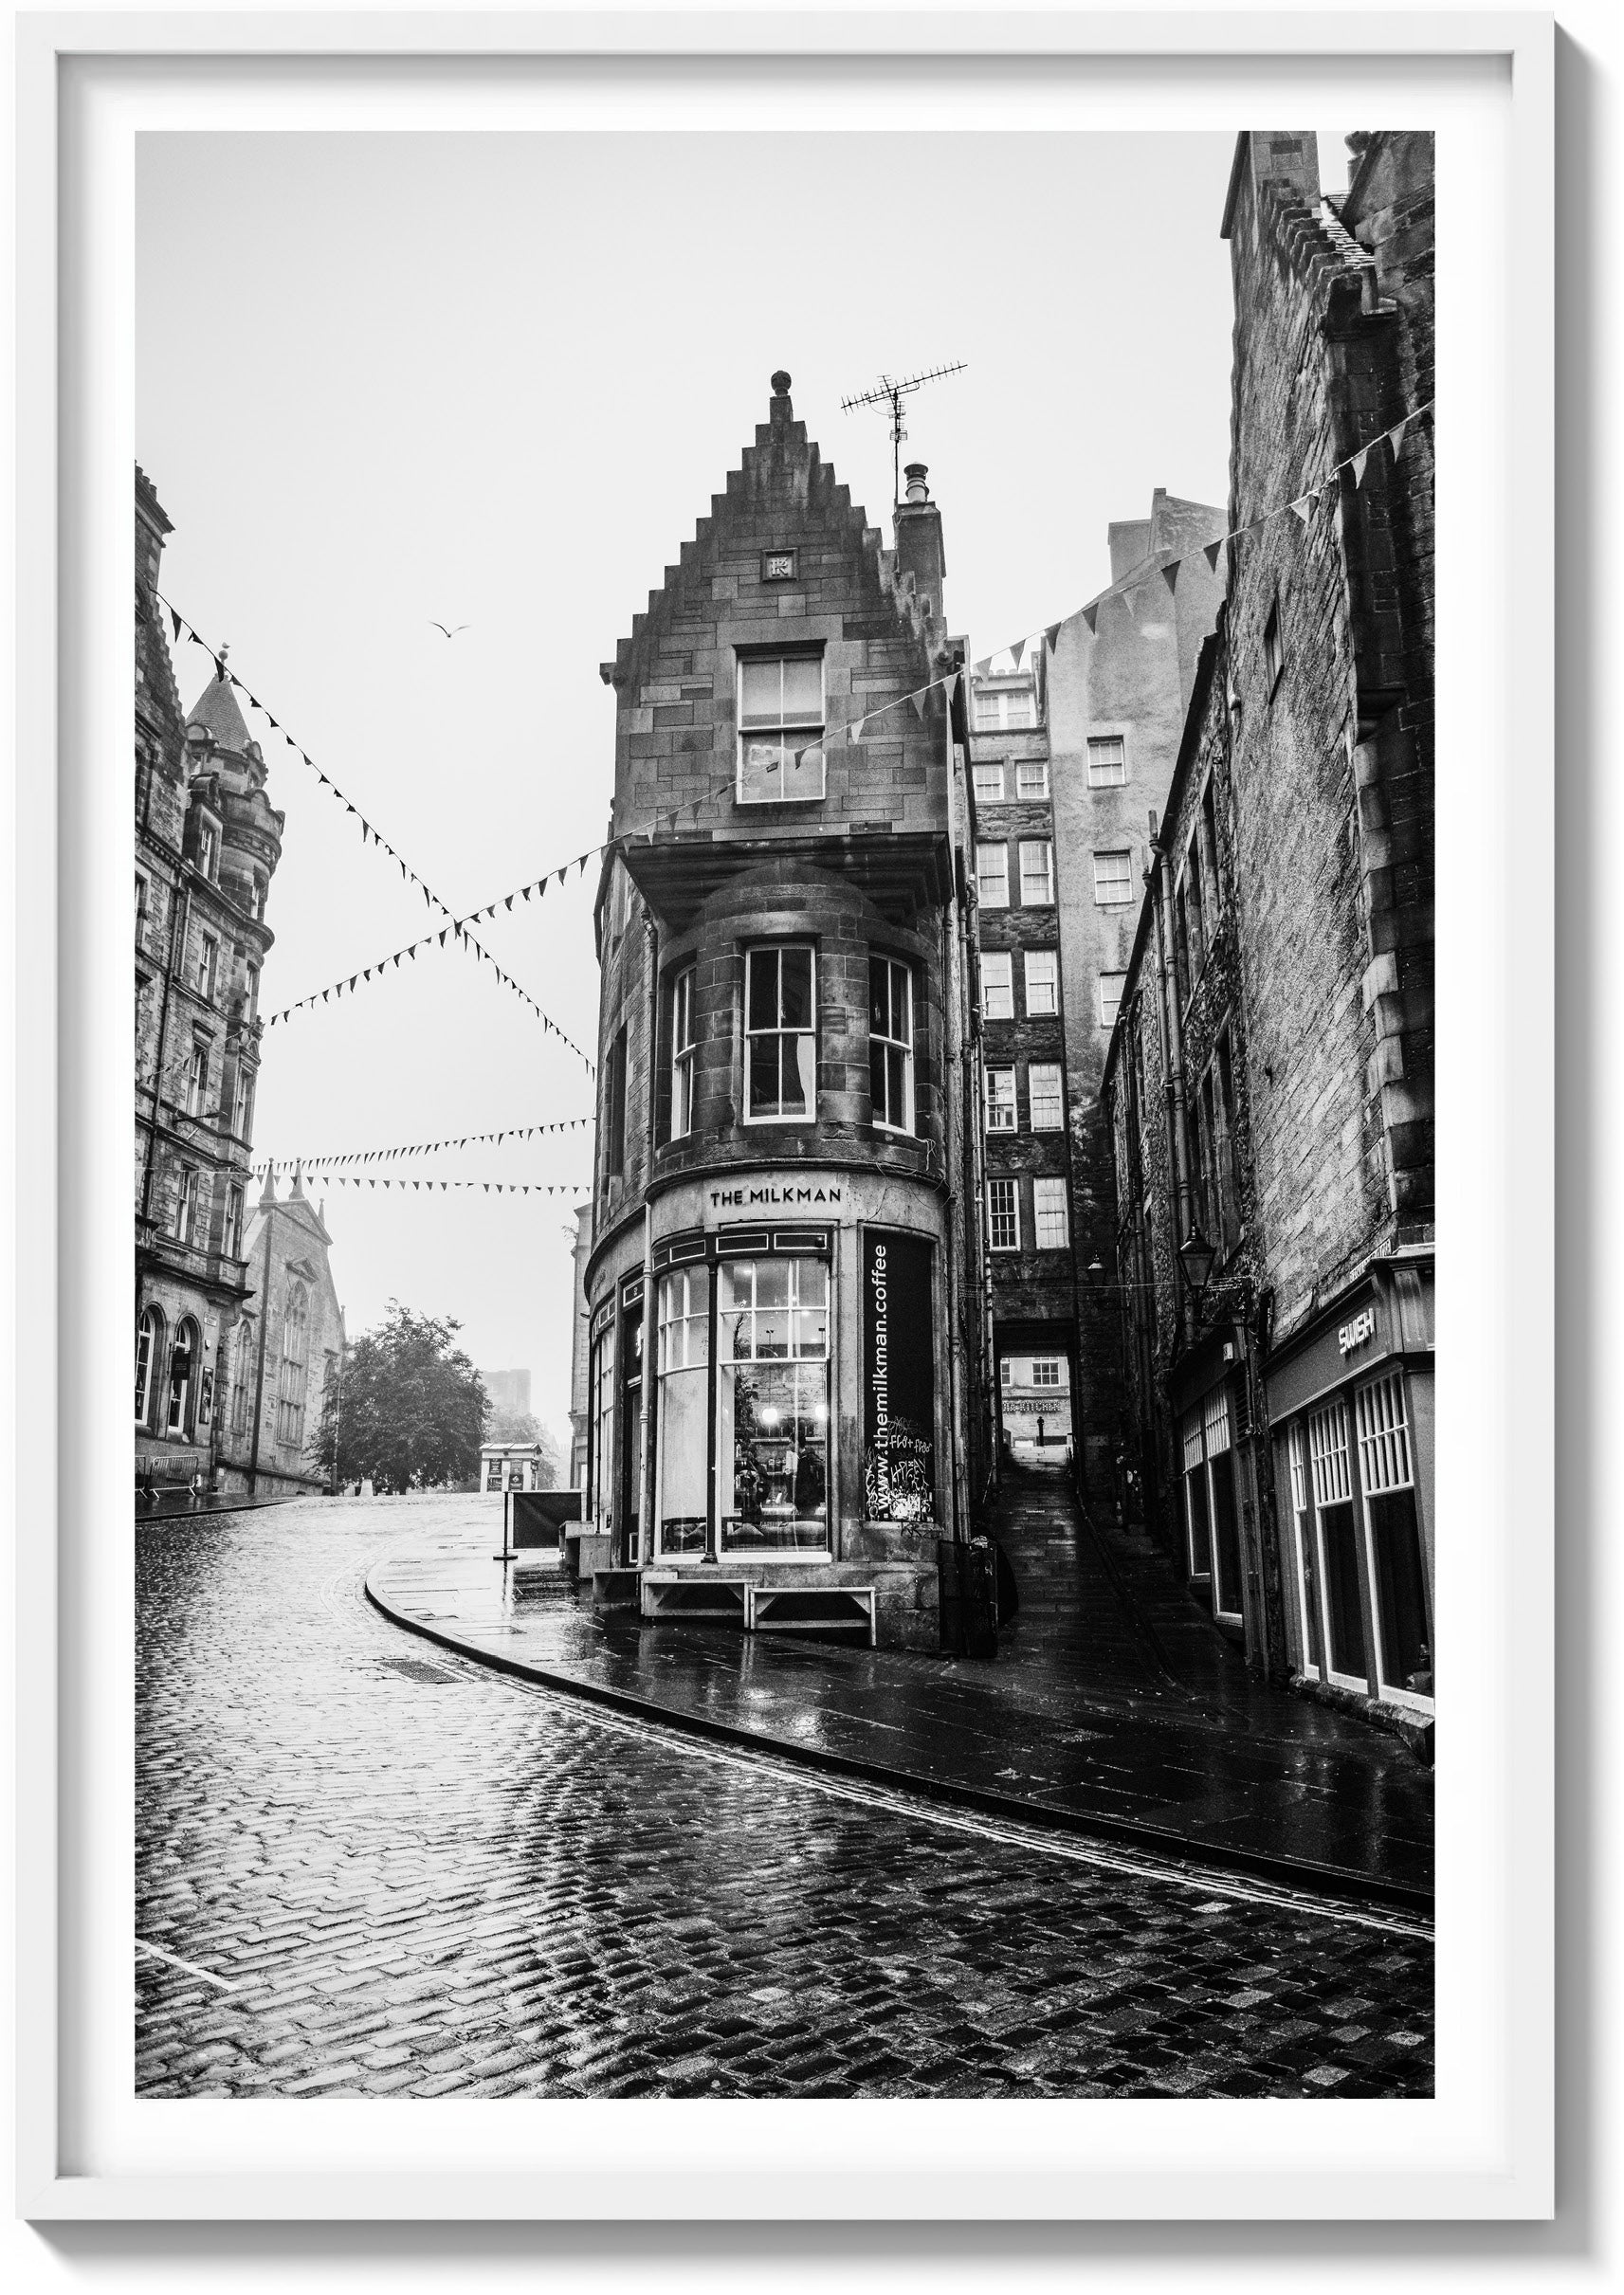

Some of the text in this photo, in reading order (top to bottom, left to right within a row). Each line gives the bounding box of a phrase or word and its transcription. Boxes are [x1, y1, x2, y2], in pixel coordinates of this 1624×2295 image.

[710, 1187, 841, 1208] THE MILKMAN
[1338, 1308, 1375, 1355] SWISH
[871, 1245, 889, 1510] www.themilkman.coffee
